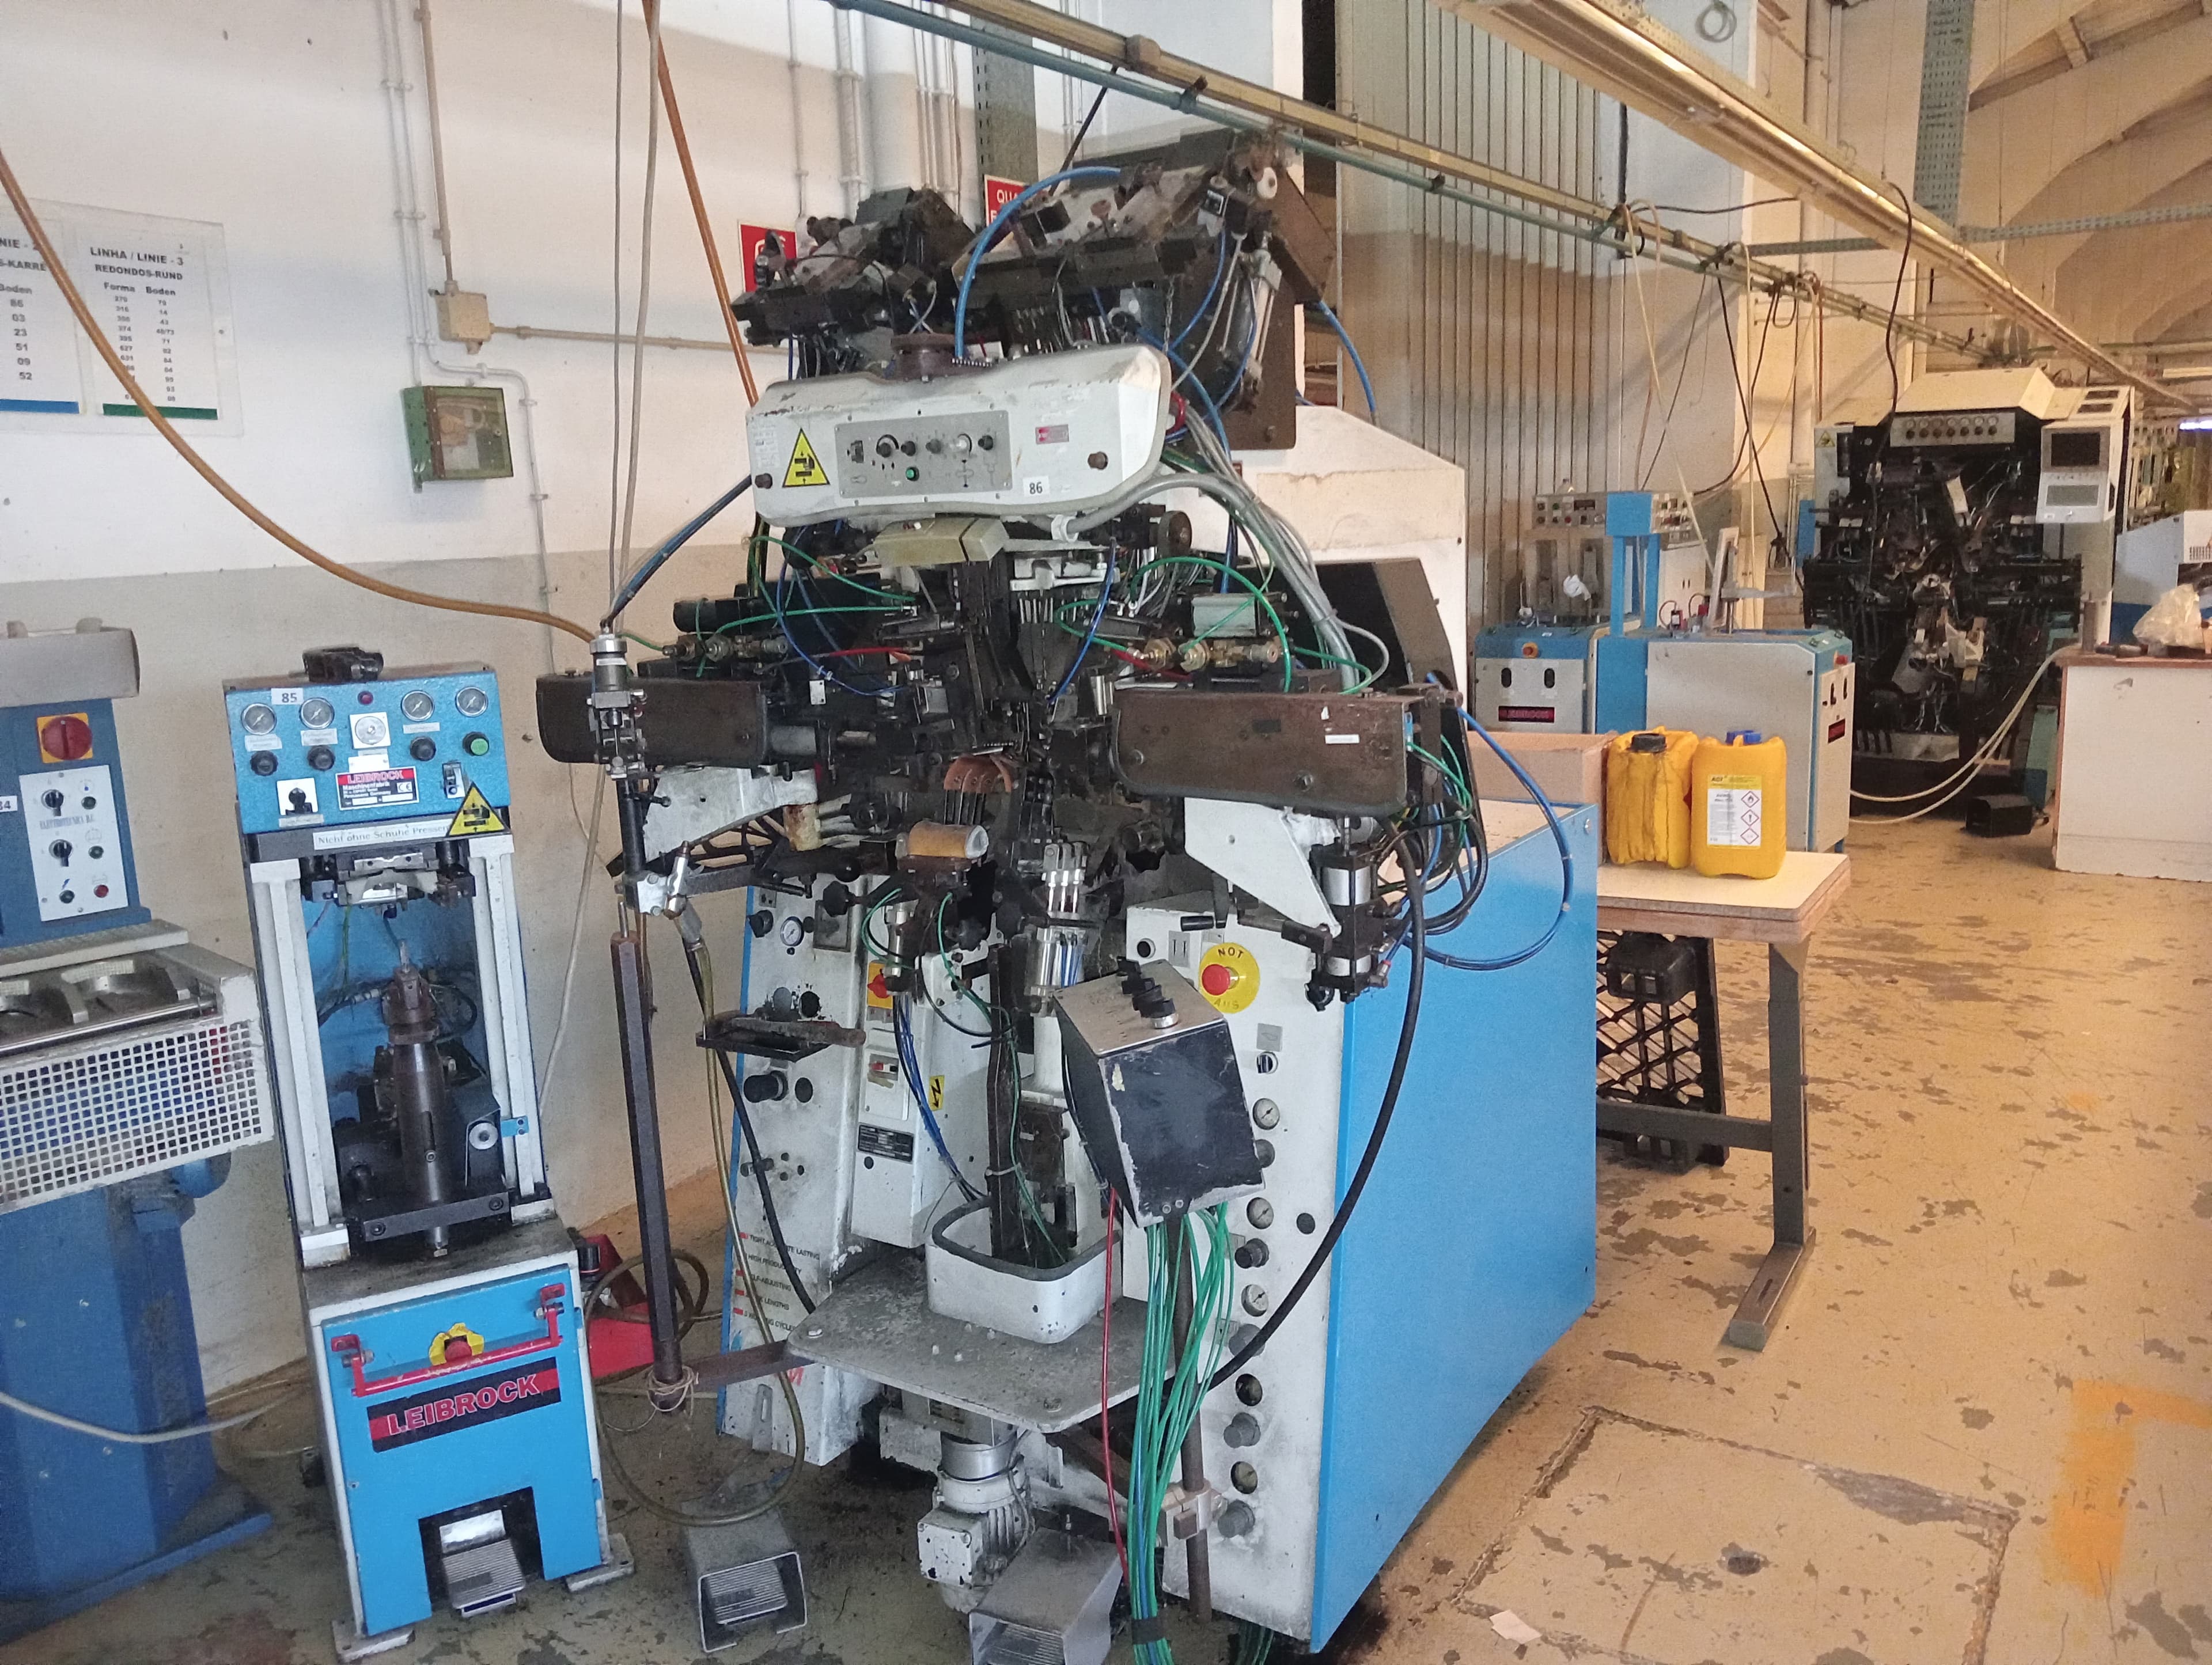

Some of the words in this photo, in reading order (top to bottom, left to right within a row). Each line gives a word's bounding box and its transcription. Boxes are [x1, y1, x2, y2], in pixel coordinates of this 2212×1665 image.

[90, 246, 127, 259] LINHA
[137, 253, 167, 264] LINIE
[177, 257, 184, 266] 3
[94, 264, 183, 280] REDONDOS-RUND
[104, 282, 135, 292] Forma
[146, 286, 176, 295] Boden
[14, 328, 28, 337] 23
[16, 343, 28, 351] 51
[19, 372, 32, 380] 52
[1029, 481, 1043, 495] 86
[282, 692, 297, 703] 85
[318, 834, 344, 844] Nicht
[347, 833, 370, 841] ohne
[374, 829, 410, 839] Schuhe
[1217, 946, 1244, 959] NOT
[387, 1373, 540, 1436] LEIBROCK
